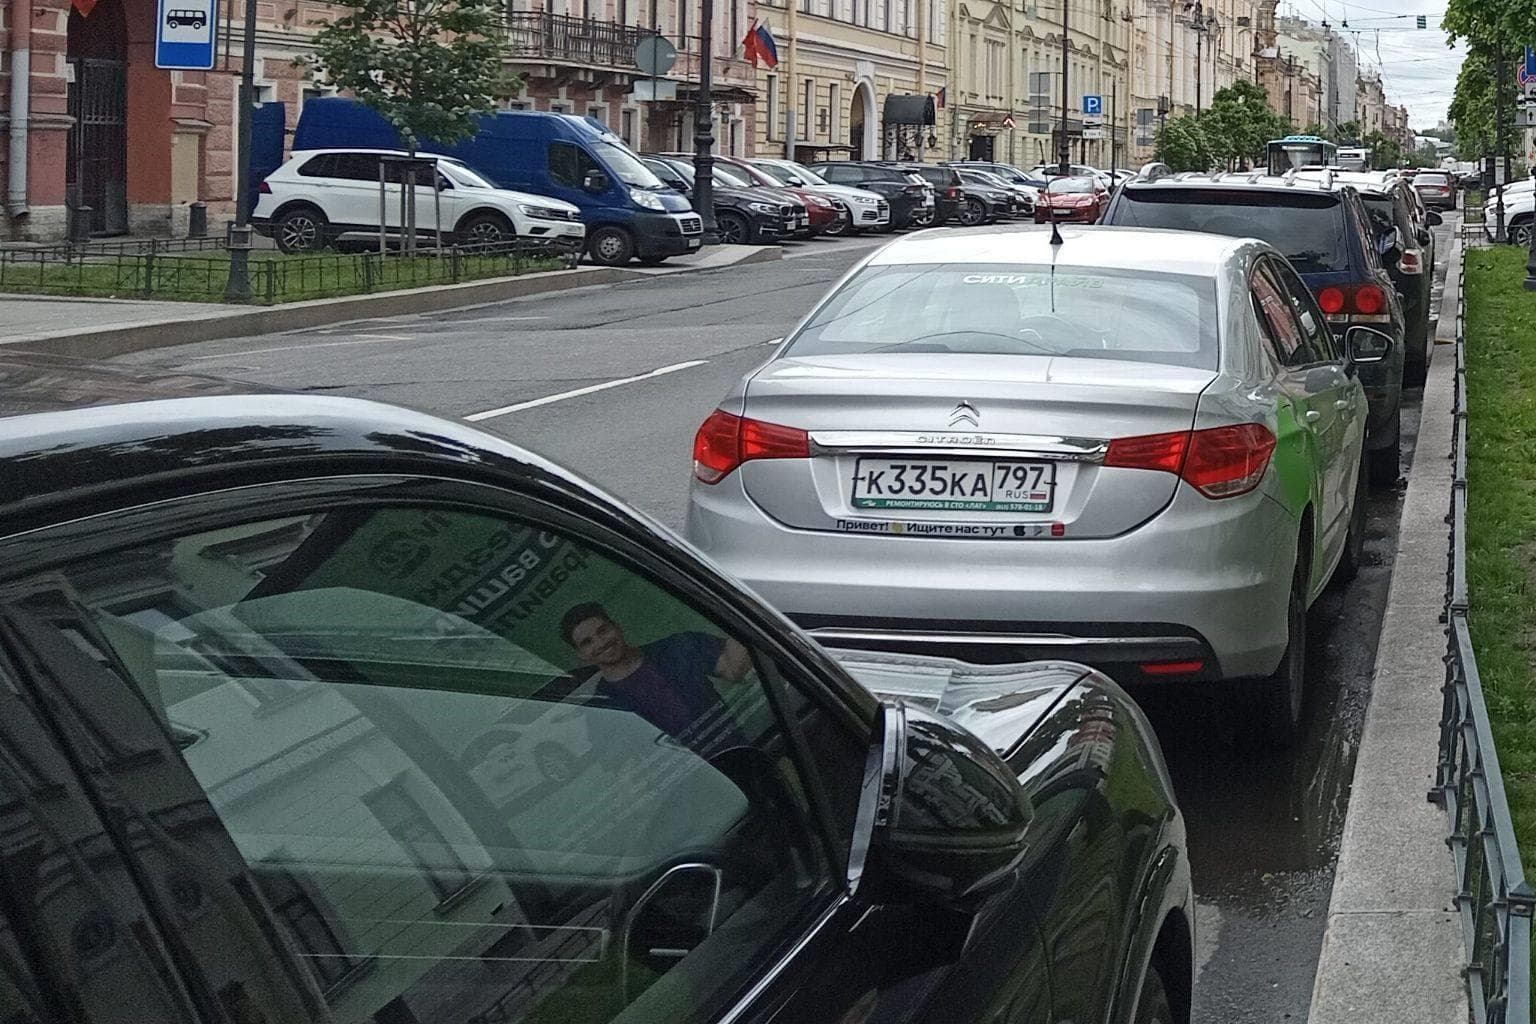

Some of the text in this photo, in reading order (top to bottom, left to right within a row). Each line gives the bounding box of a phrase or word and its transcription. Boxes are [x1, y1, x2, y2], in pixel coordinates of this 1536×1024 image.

[997, 465, 1045, 491] 797
[1005, 490, 1029, 499] RUS
[837, 519, 1007, 537] Привет! Ищите нас тут
